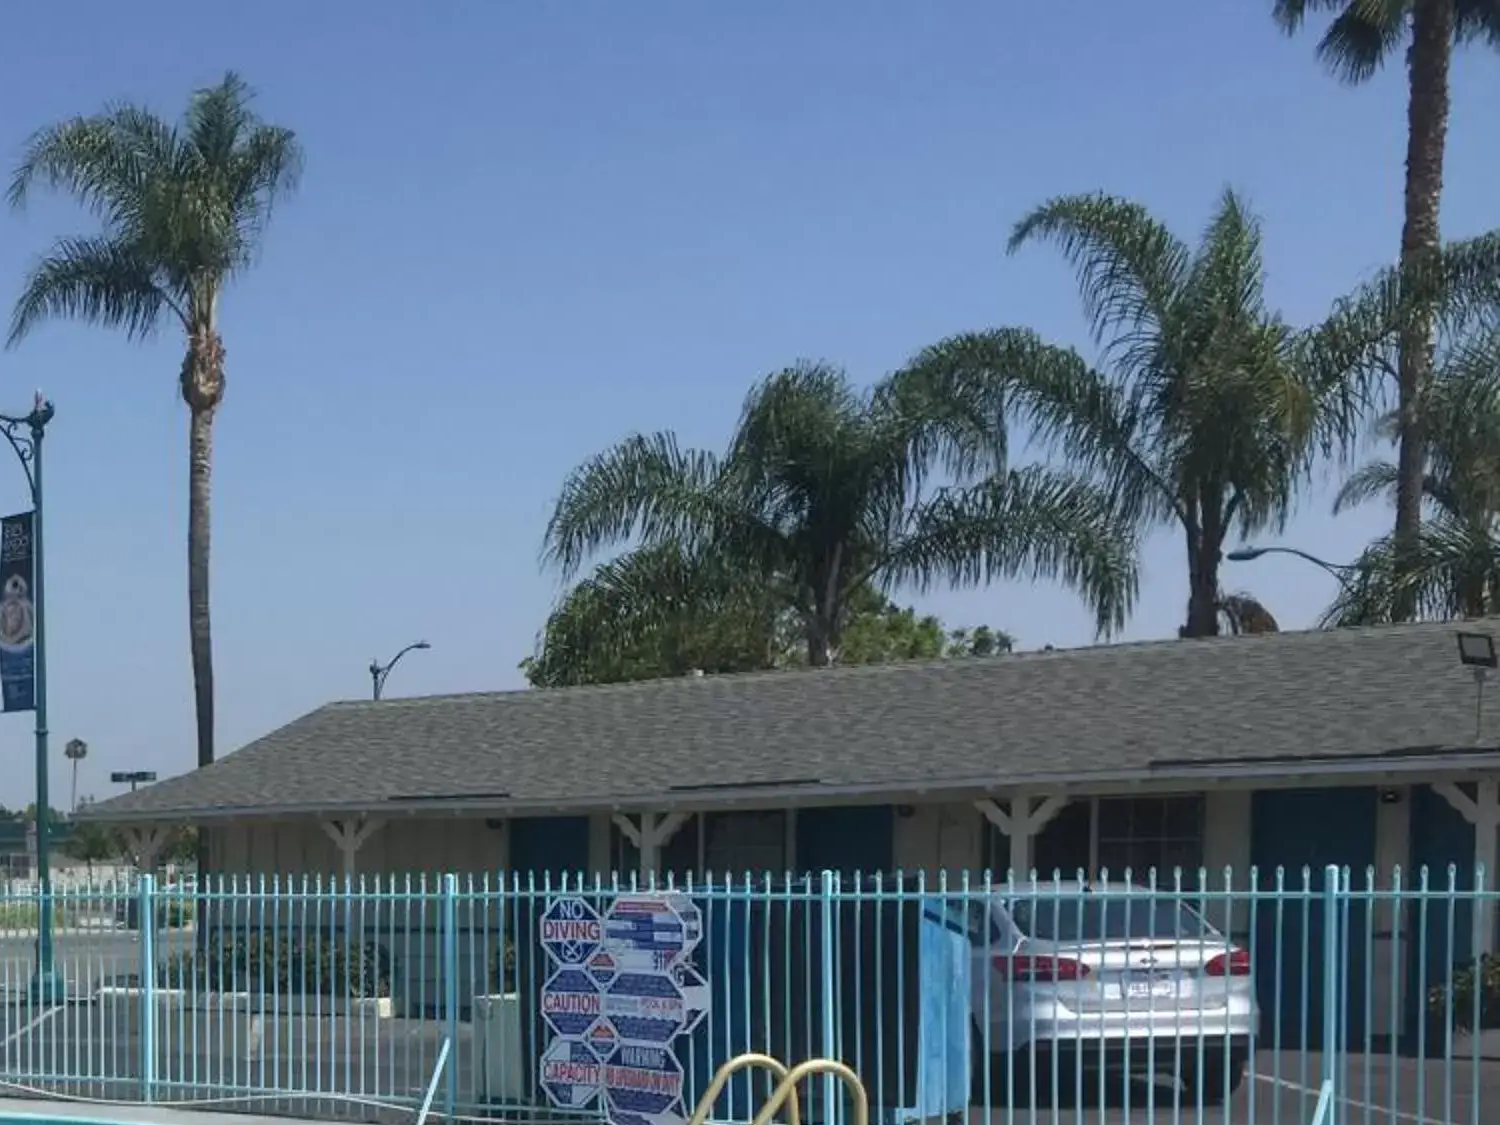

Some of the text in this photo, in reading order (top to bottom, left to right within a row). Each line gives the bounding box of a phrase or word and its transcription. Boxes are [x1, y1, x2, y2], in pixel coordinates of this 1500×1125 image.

[560, 901, 584, 919] NO
[544, 922, 600, 940] DIVING
[544, 993, 601, 1013] CAUTION
[544, 1062, 601, 1083] CAPACITY
